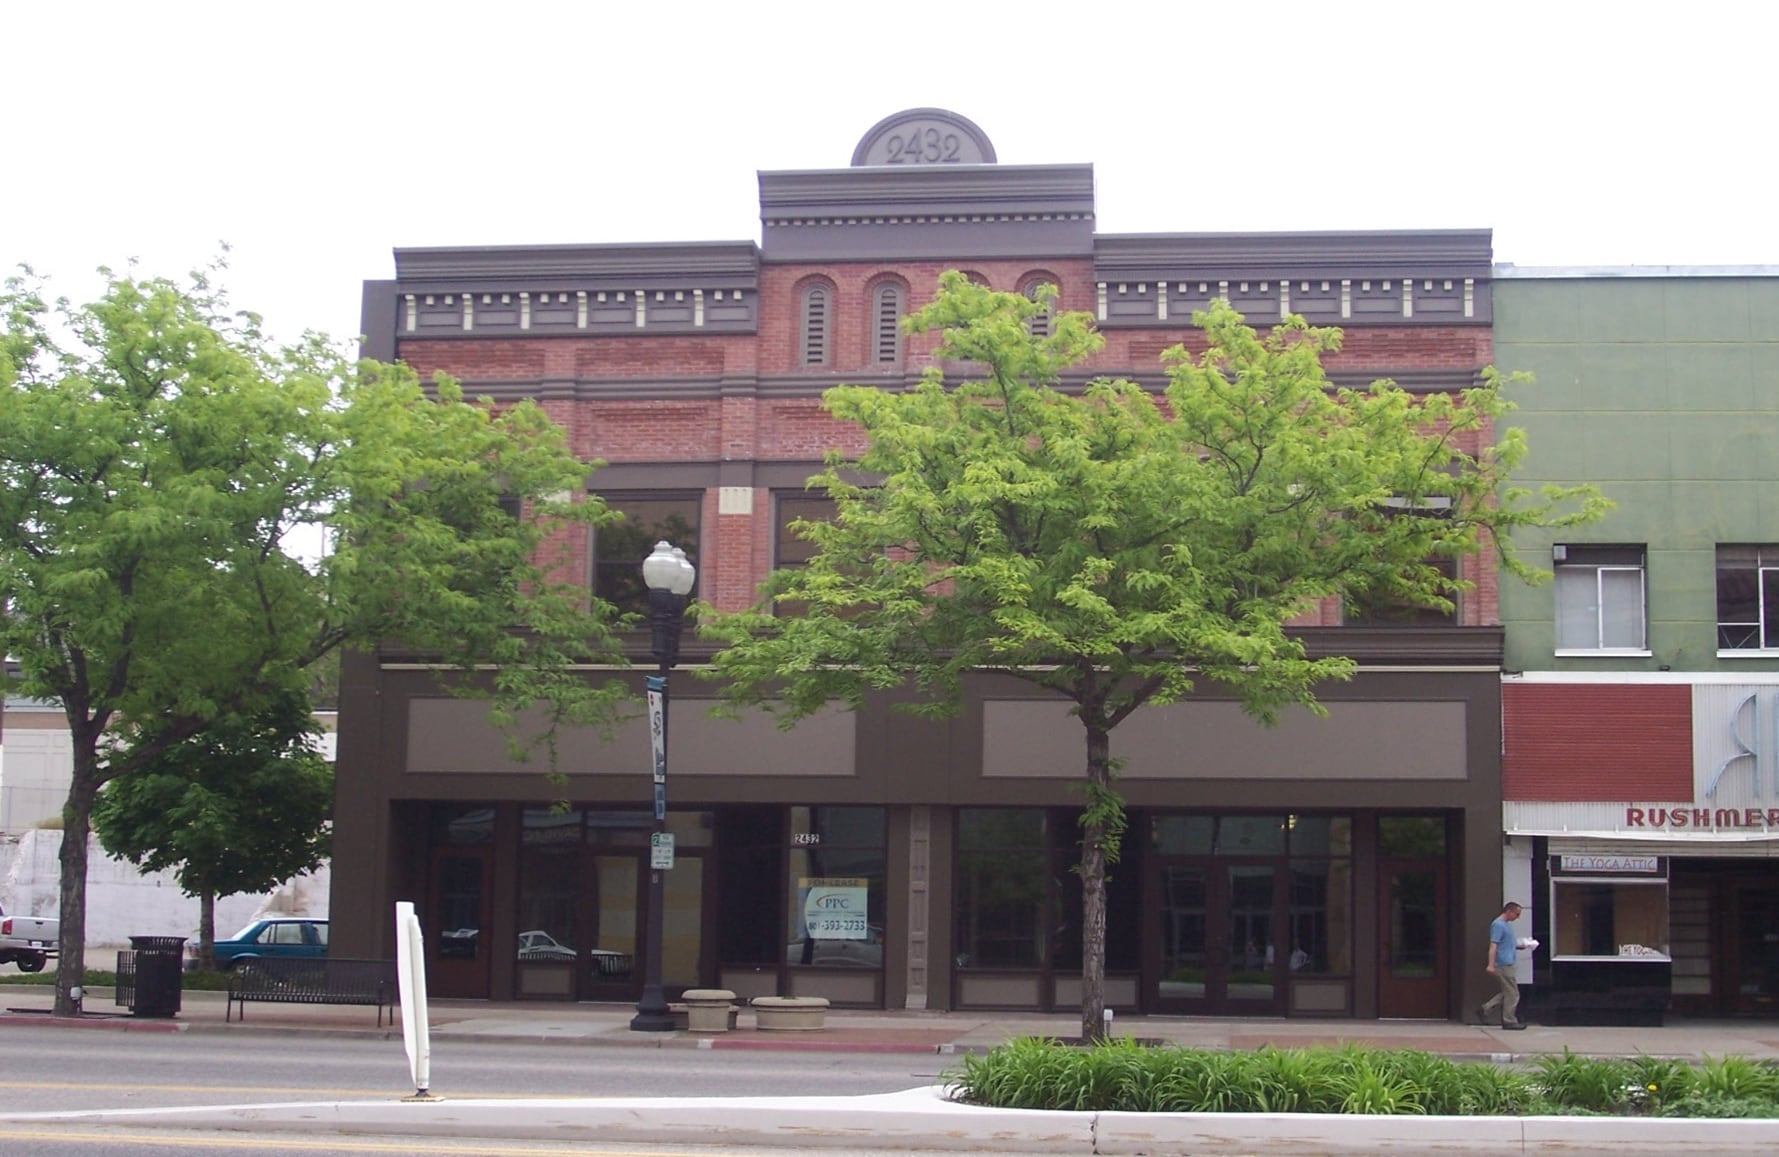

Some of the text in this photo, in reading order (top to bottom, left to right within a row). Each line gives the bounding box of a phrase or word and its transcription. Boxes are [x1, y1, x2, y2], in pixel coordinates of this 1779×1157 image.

[887, 127, 961, 163] 2432
[795, 833, 820, 844] 2432
[1563, 856, 1656, 870] THE YOGA ATTIC
[825, 898, 849, 909] PPC
